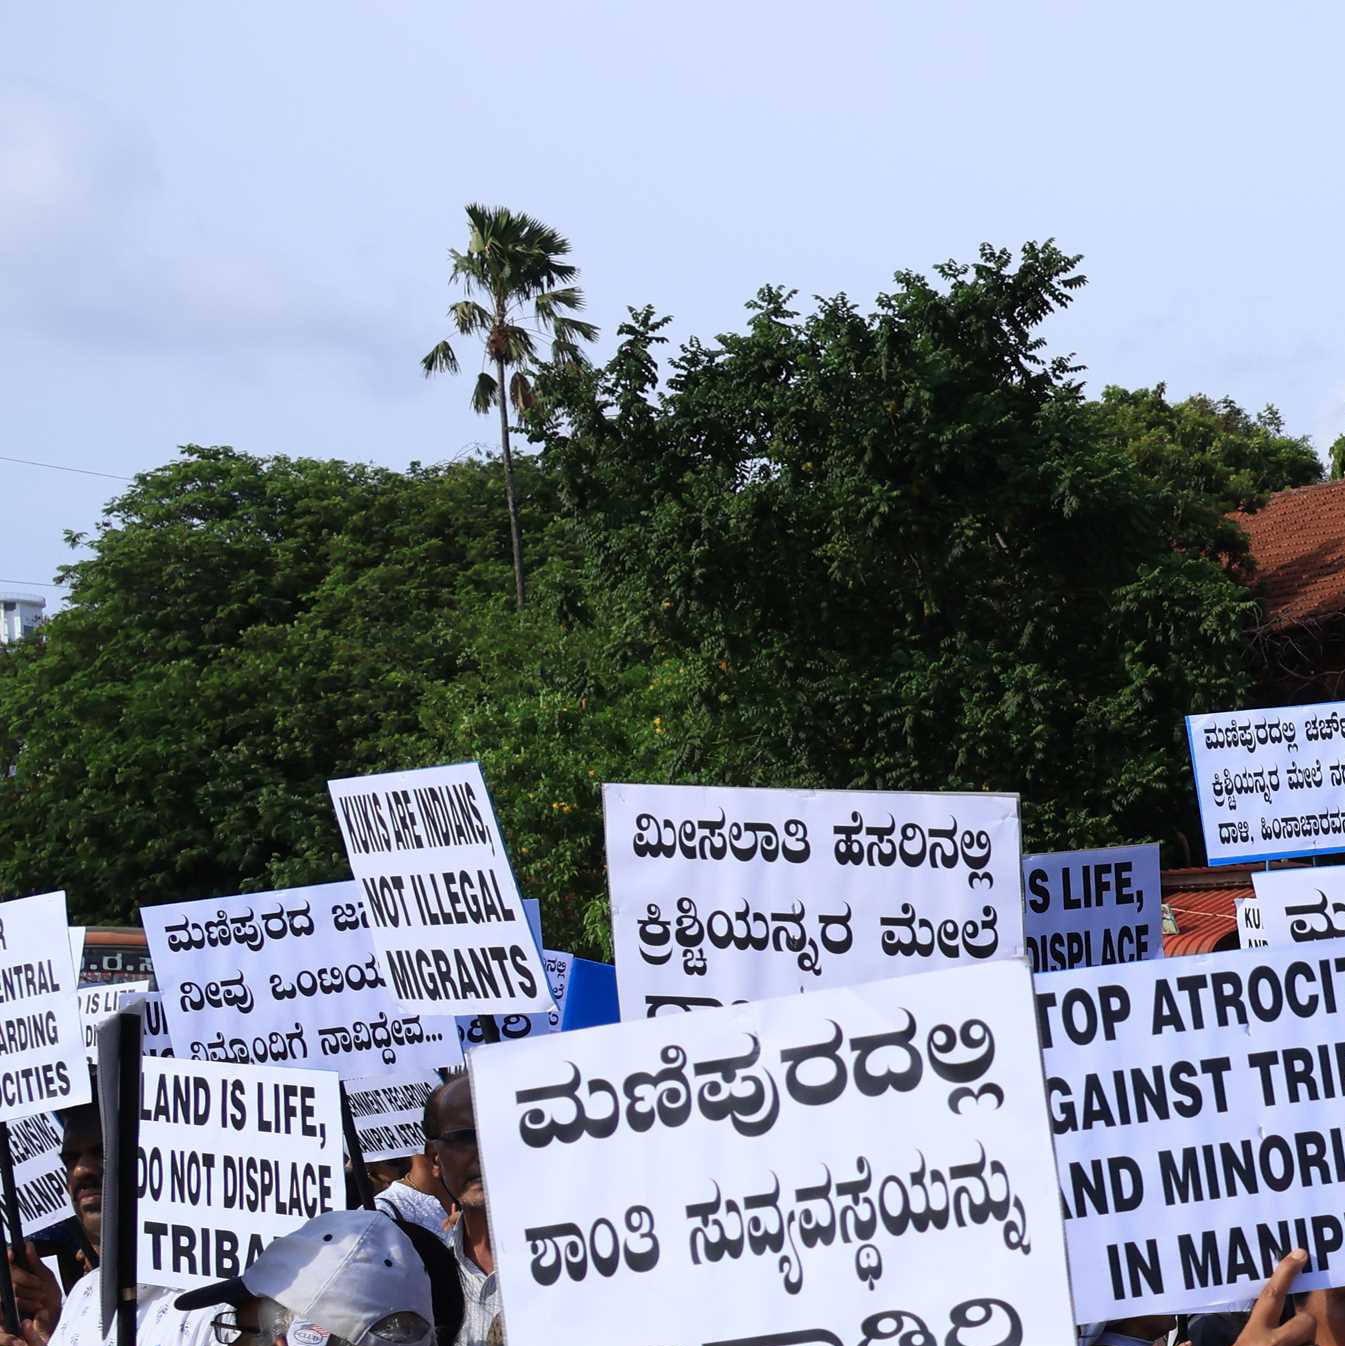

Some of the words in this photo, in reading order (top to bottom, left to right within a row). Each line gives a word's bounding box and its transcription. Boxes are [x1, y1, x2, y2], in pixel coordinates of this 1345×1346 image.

[1287, 758, 1323, 790] ಮೇಲೆ
[340, 791, 390, 855] KUKIS
[390, 788, 423, 850] ARE
[413, 782, 495, 856] INDIANS,
[633, 807, 811, 865] ಮೀಸಲಾತಿ
[833, 810, 994, 890] ಹೆಸರಿನಲ್ಲಿ
[362, 875, 411, 928] NOT
[410, 869, 516, 926] ILLEGAL
[1023, 868, 1050, 914] S
[1062, 861, 1143, 912] LIFE,
[164, 899, 315, 952] ಮಣಿಪುರದ
[880, 902, 999, 960] ಮೇಲೆ
[1026, 924, 1149, 973] DISPLACE
[0, 959, 60, 1003] NTRAL
[269, 951, 387, 1001] ಒಂಟಿಯ
[386, 944, 538, 1001] MIGRANTS
[1035, 984, 1131, 1049] TOP
[0, 1061, 71, 1108] CITIES
[515, 1007, 1005, 1148] ಮಣಿಪುರದಲ್ಲಿ
[1045, 1056, 1231, 1134] GAINST
[141, 1071, 211, 1126] LAND
[221, 1078, 247, 1131] IS
[257, 1082, 327, 1149] LIFE,
[358, 1126, 399, 1153] ANIPUR
[136, 1146, 163, 1201] DO
[171, 1150, 215, 1206] NOT
[224, 1155, 334, 1219] DISPLACE
[143, 1221, 281, 1278] TRIBA
[525, 1206, 660, 1286] ಶಾಂತಿ
[1106, 1238, 1164, 1300] IN
